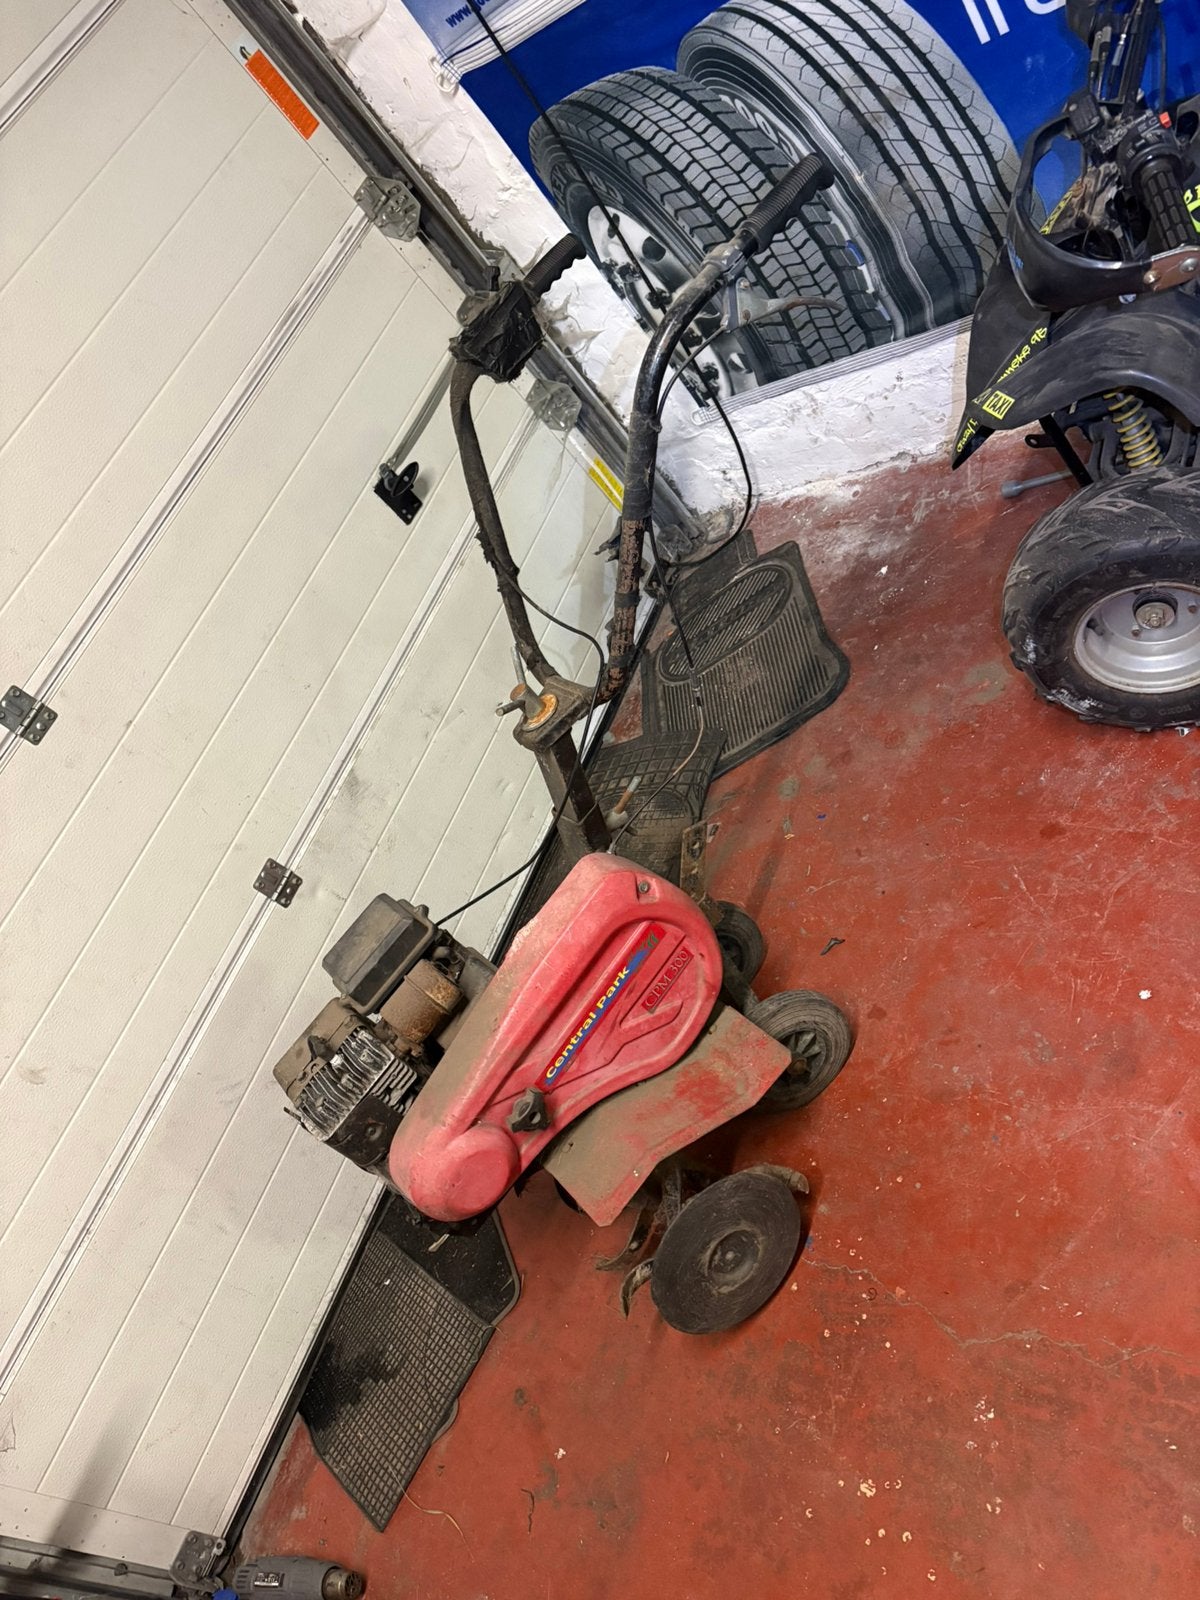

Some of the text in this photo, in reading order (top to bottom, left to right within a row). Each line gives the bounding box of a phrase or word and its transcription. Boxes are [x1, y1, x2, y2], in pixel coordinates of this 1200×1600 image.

[546, 965, 630, 1079] Central Park
[645, 950, 690, 1009] CPM 300
